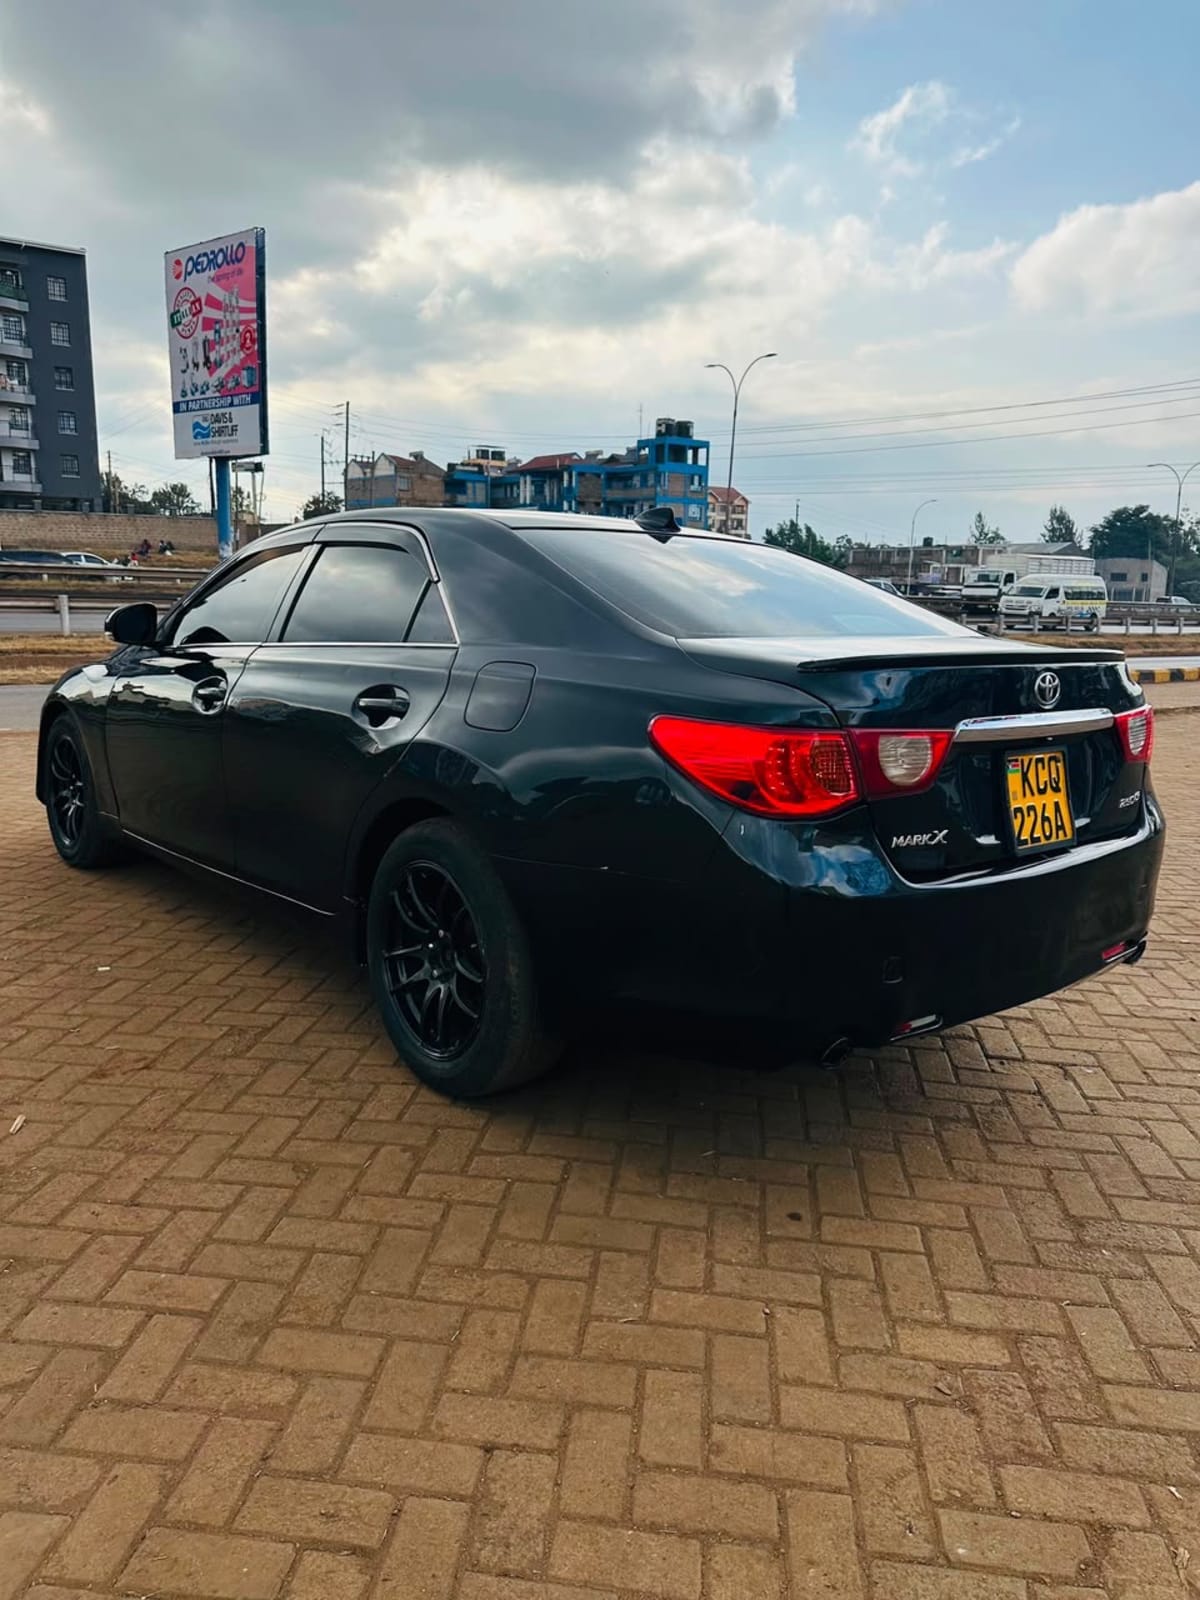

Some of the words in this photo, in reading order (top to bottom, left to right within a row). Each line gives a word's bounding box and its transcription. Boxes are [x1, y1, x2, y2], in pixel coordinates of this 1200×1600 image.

[184, 241, 246, 282] PEDROLLO
[179, 402, 187, 412] IN
[188, 396, 232, 411] PARTNERSHIP
[233, 393, 251, 406] WITH
[210, 412, 228, 425] DAVIS
[1020, 755, 1062, 798] KCQ
[1013, 800, 1068, 847] 226A
